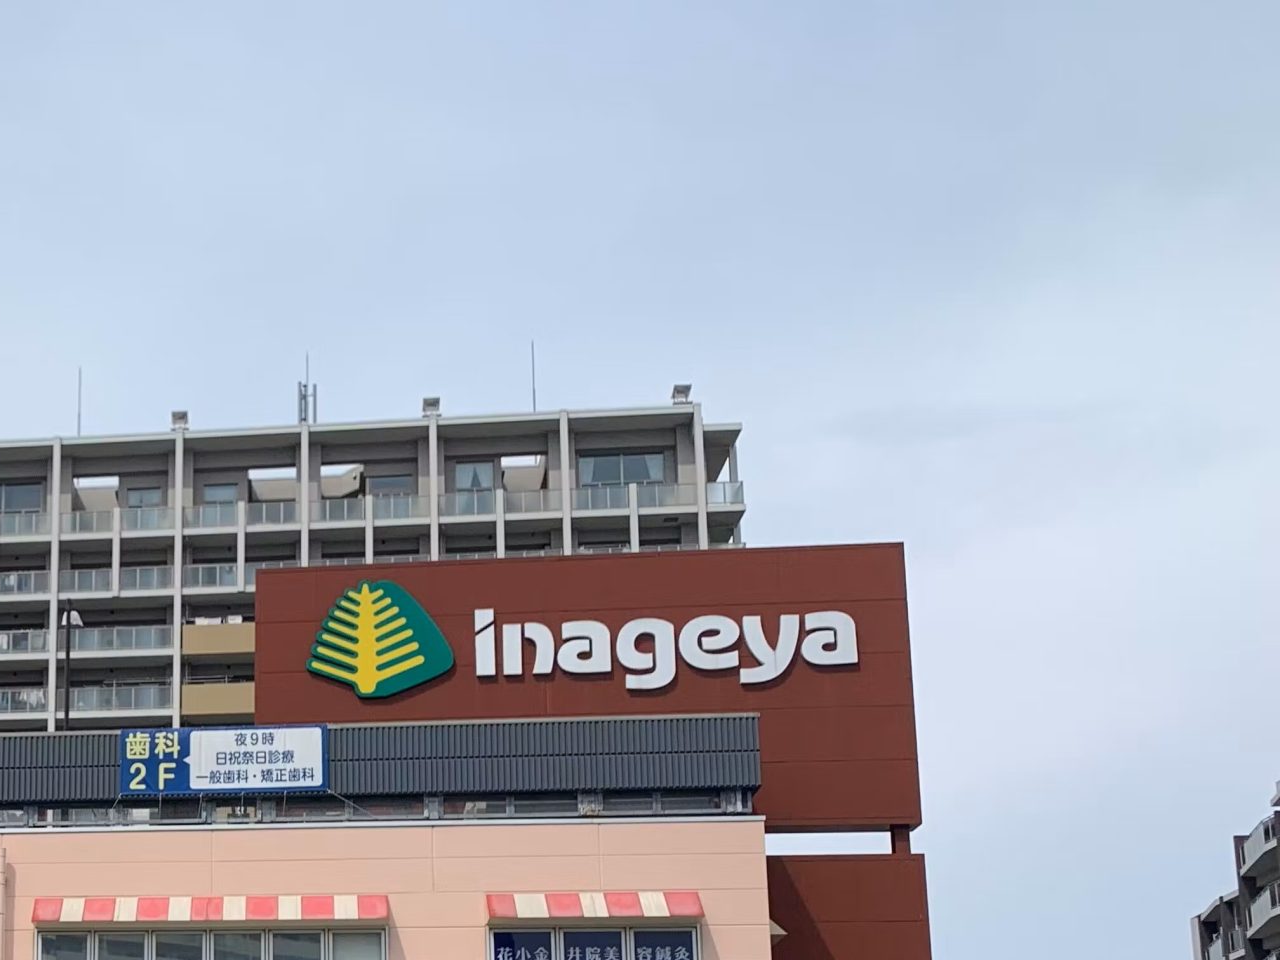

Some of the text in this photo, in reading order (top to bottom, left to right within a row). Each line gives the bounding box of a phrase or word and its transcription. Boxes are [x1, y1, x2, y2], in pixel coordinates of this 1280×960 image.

[474, 608, 859, 690] inageya
[125, 731, 181, 760] 歯科
[234, 732, 275, 747] 夜9時
[216, 750, 295, 766] 日祝祭日診療
[129, 762, 177, 790] 2F
